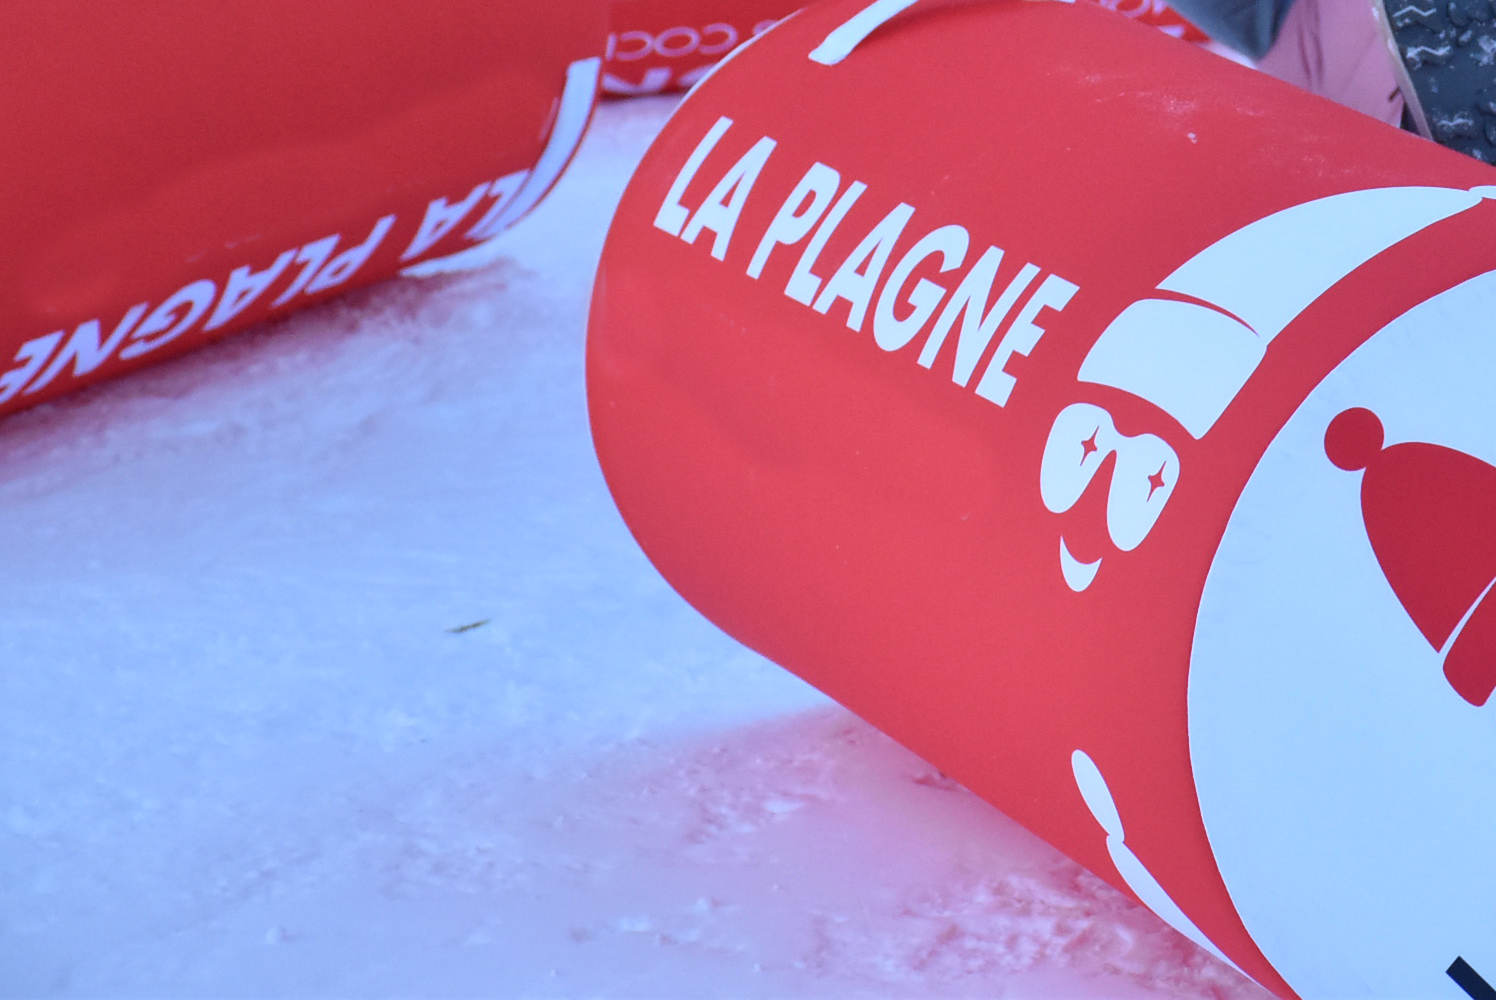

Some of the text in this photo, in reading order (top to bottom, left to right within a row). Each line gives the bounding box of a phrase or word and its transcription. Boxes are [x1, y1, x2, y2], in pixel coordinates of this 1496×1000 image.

[400, 168, 532, 262] LA
[653, 115, 1080, 408] LA PLAGNE
